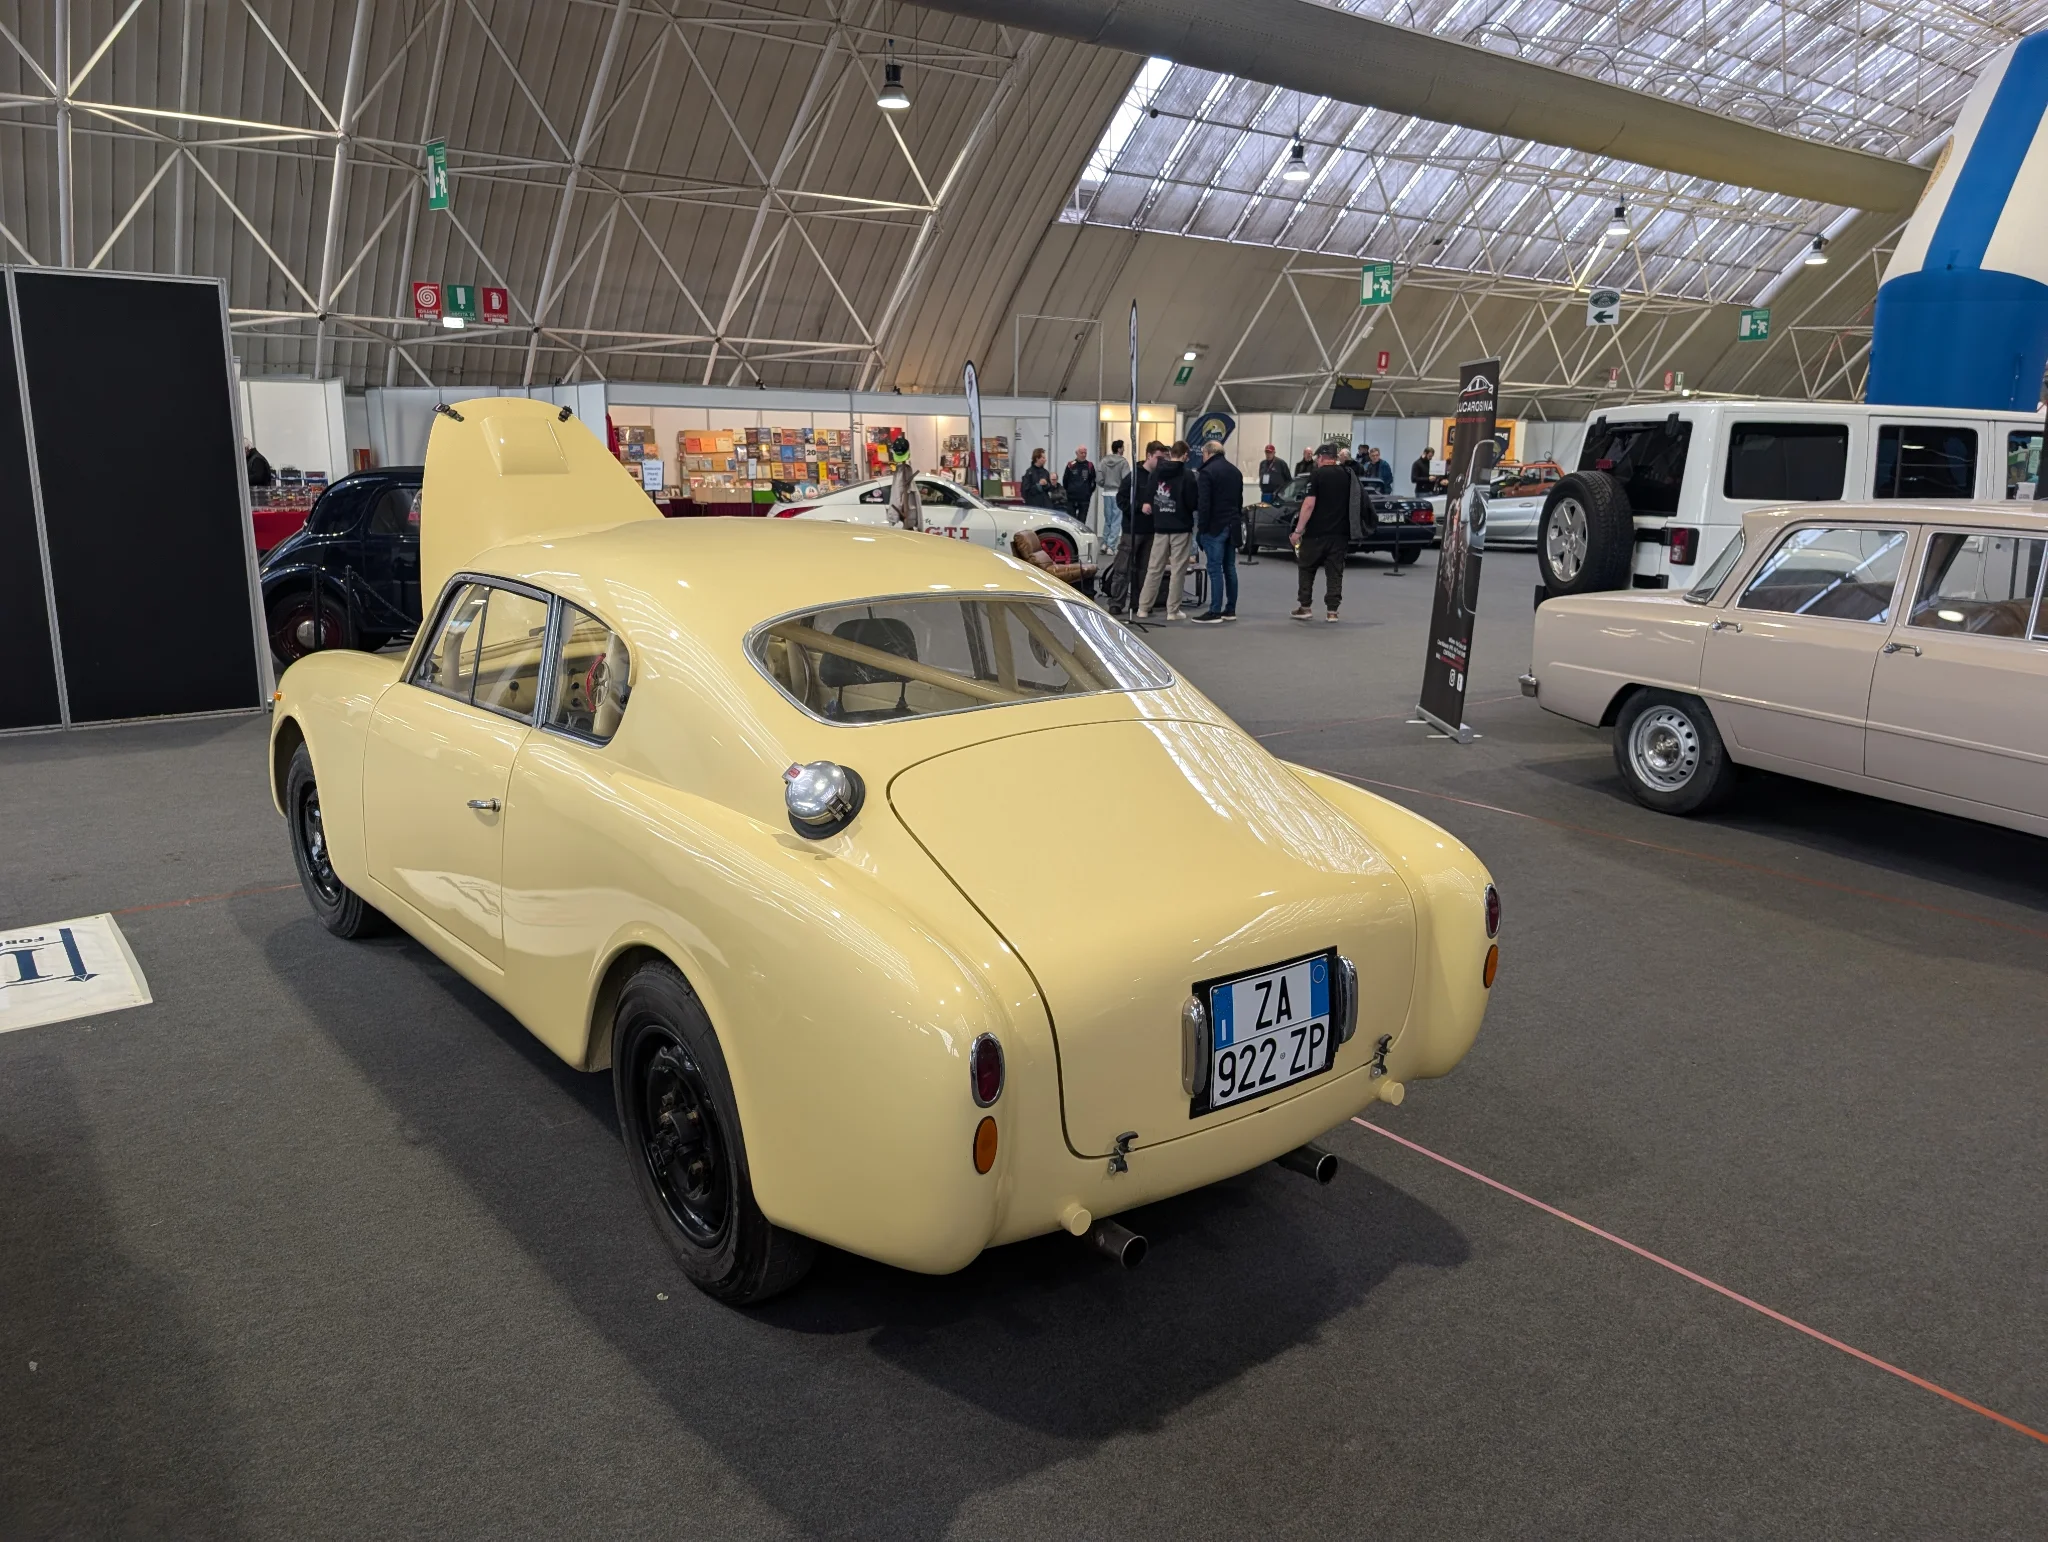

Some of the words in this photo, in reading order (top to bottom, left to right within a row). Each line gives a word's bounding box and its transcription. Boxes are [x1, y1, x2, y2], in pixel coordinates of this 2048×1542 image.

[925, 526, 969, 540] GTI
[1254, 976, 1292, 1031] ZA
[1218, 1038, 1277, 1098] 922
[1289, 1023, 1325, 1076] ZP
